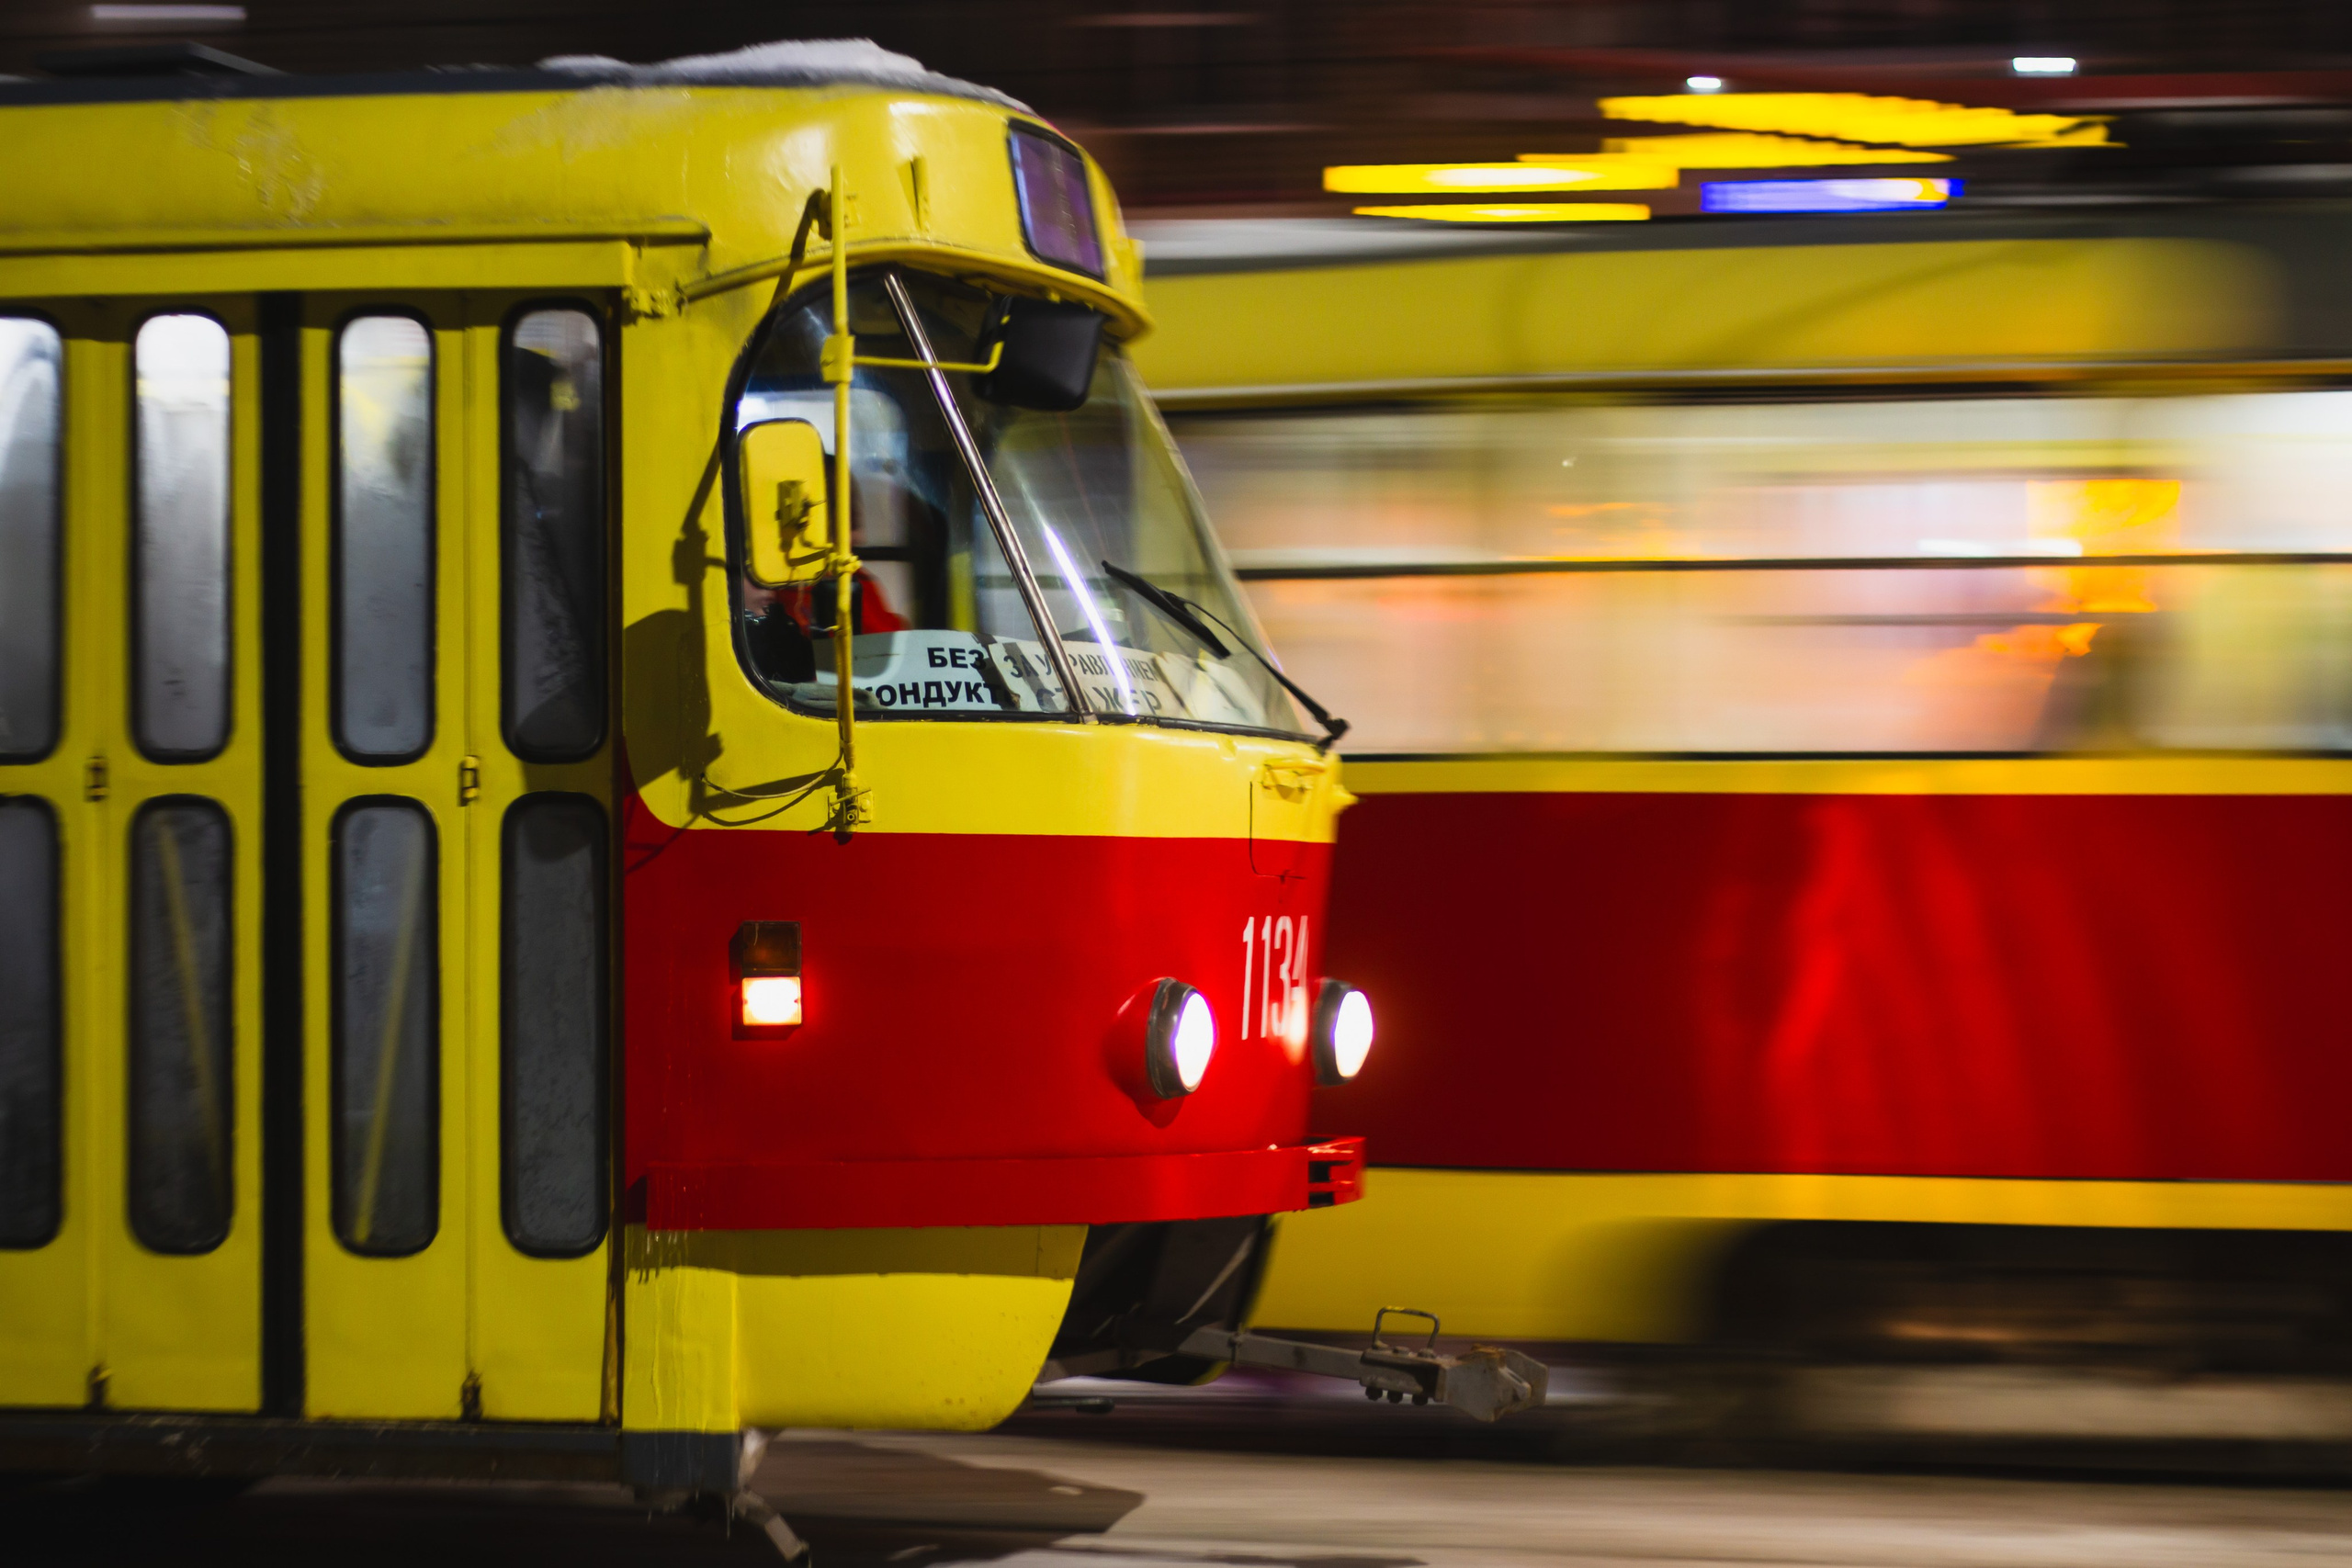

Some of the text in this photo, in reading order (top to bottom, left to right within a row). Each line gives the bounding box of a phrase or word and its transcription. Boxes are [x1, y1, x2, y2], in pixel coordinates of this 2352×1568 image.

[927, 647, 986, 670] БЕЗ
[1003, 654, 1039, 678] ЗА
[865, 681, 1001, 708] ОНДУКТ
[1241, 915, 1308, 1041] 1134
